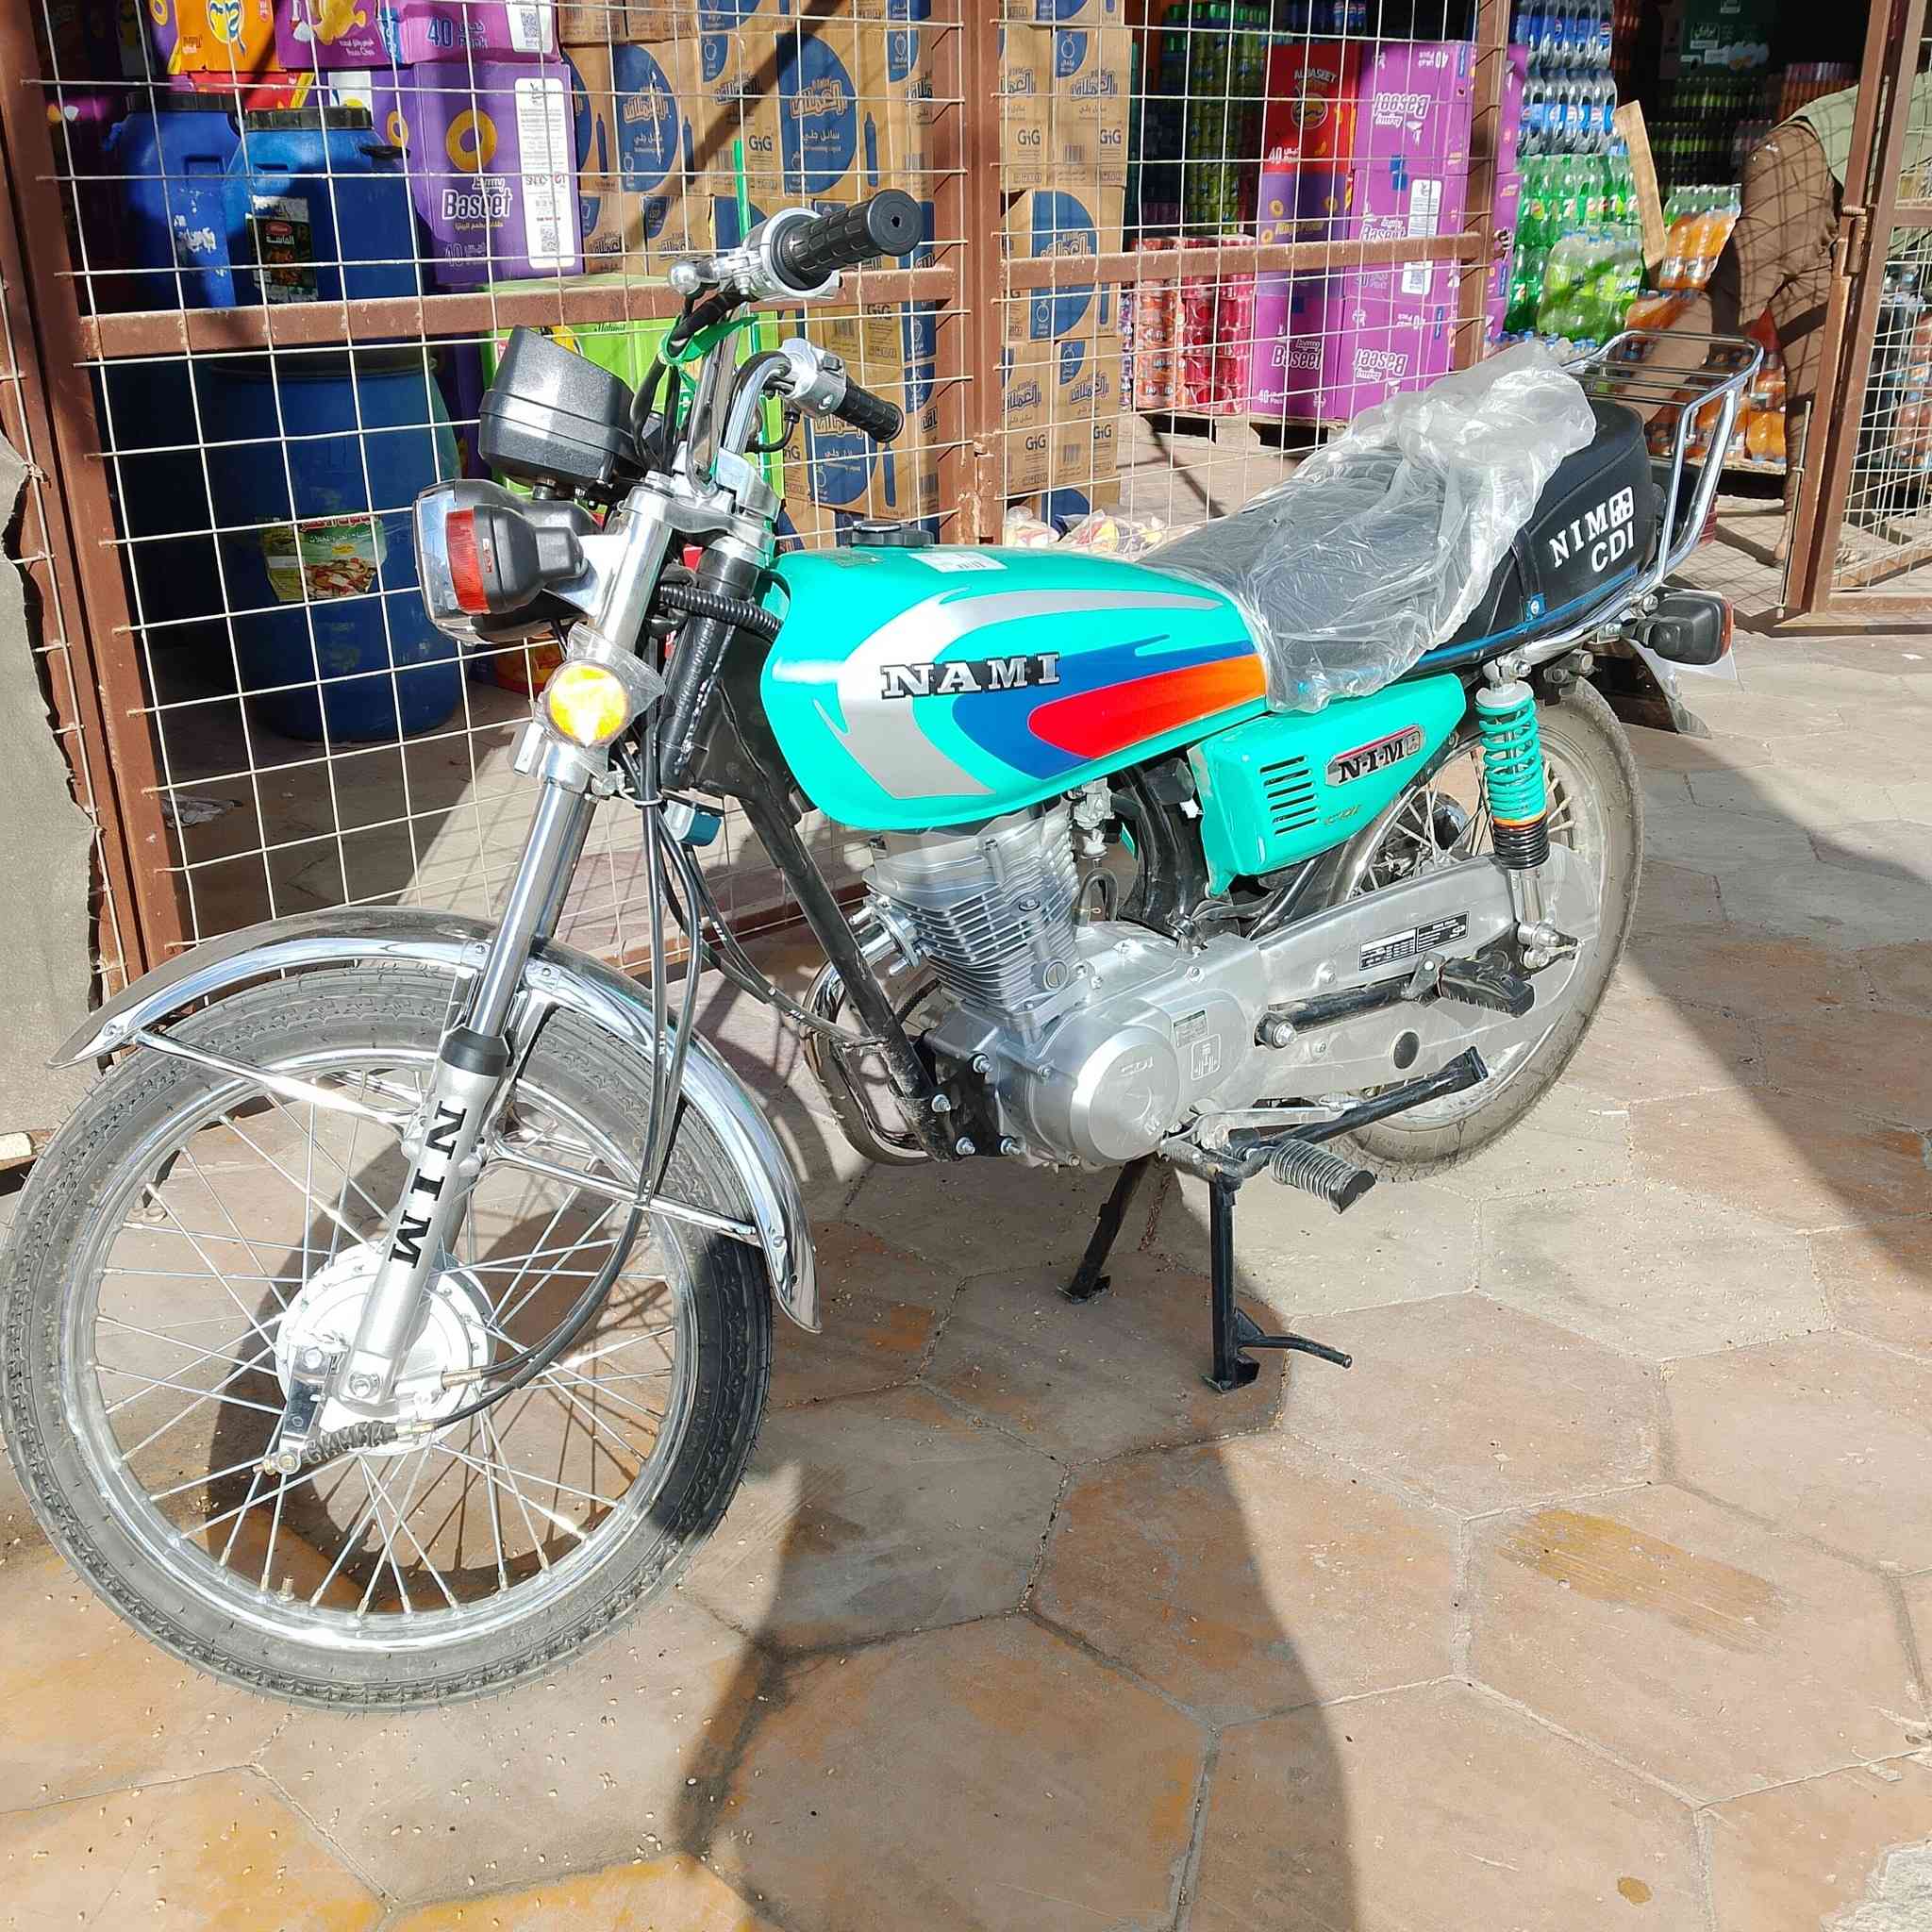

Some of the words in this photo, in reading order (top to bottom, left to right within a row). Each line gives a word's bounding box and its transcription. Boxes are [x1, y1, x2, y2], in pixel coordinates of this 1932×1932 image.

[426, 14, 454, 47] 40
[748, 135, 773, 152] GiG
[1017, 129, 1041, 146] GiG
[1100, 129, 1122, 144] GiG
[1025, 434, 1046, 451] GiG
[1591, 522, 1635, 573] CDI
[880, 652, 1062, 700] NAMI
[389, 1100, 468, 1269] NIM
